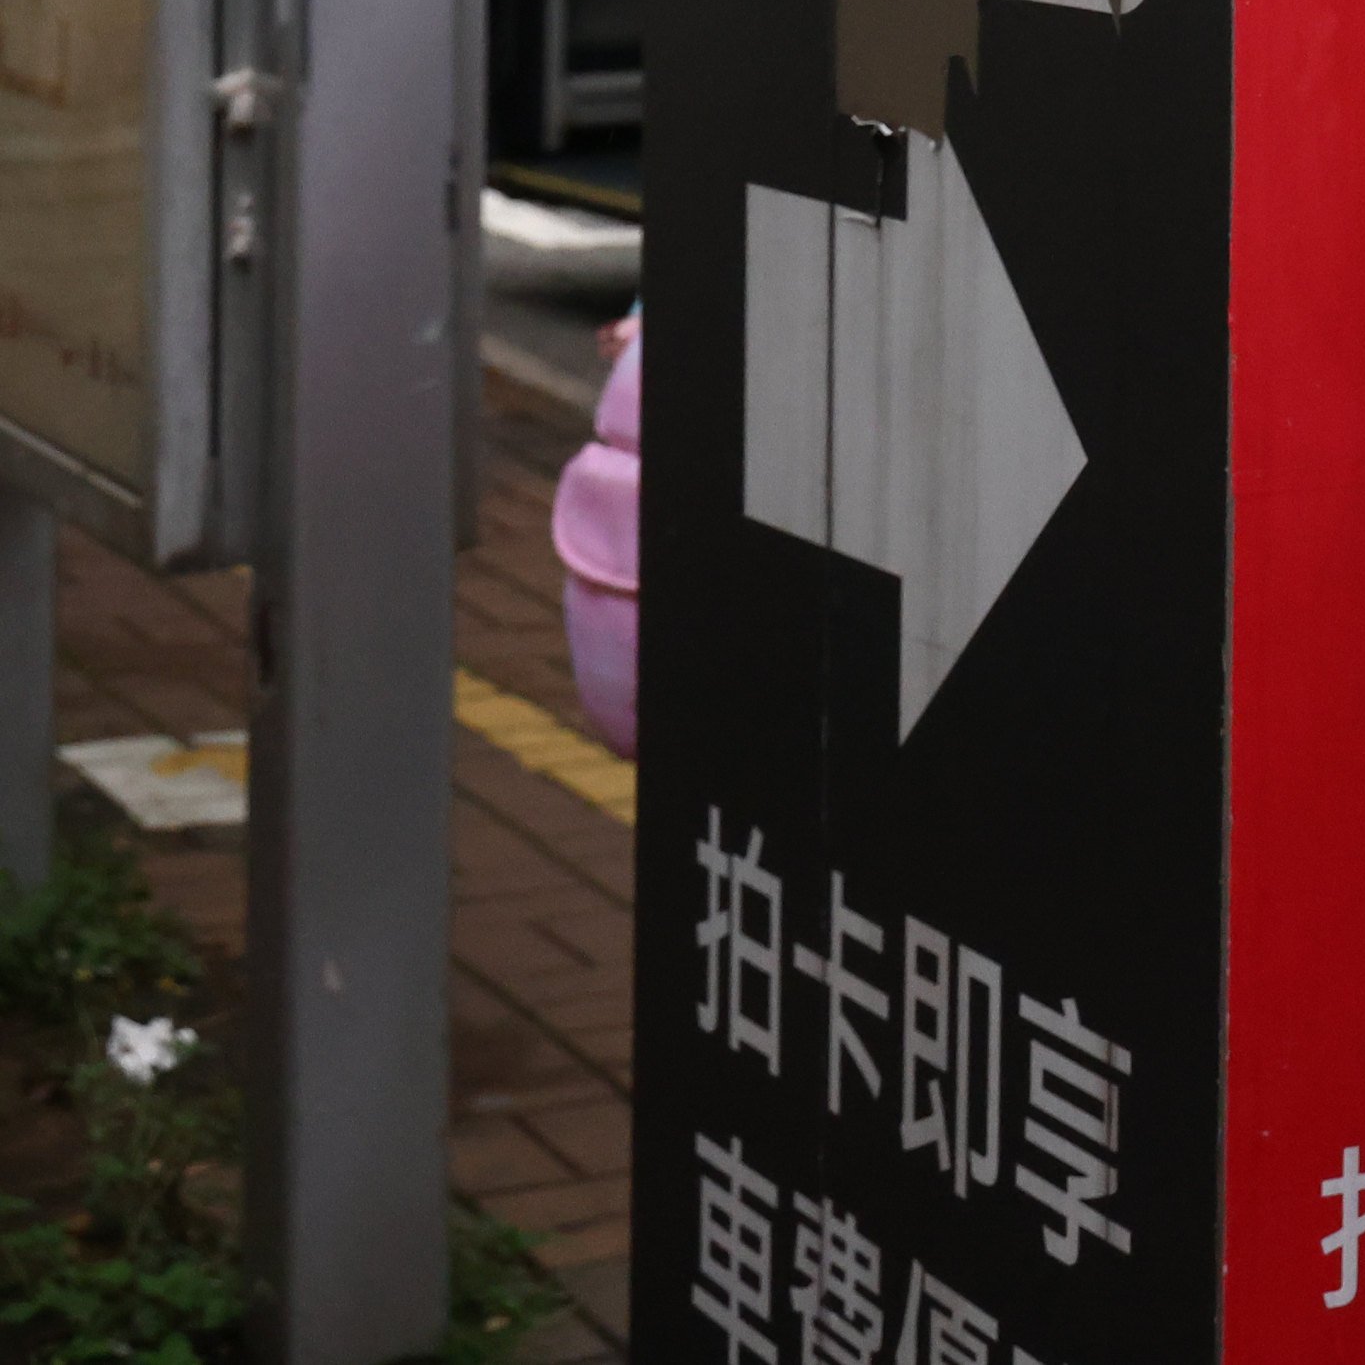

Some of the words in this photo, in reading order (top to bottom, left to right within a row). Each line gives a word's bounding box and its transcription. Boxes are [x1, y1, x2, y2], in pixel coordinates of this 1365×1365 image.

[696, 805, 1131, 1266] 拍卡即享
[691, 1132, 1075, 1365] 車費
